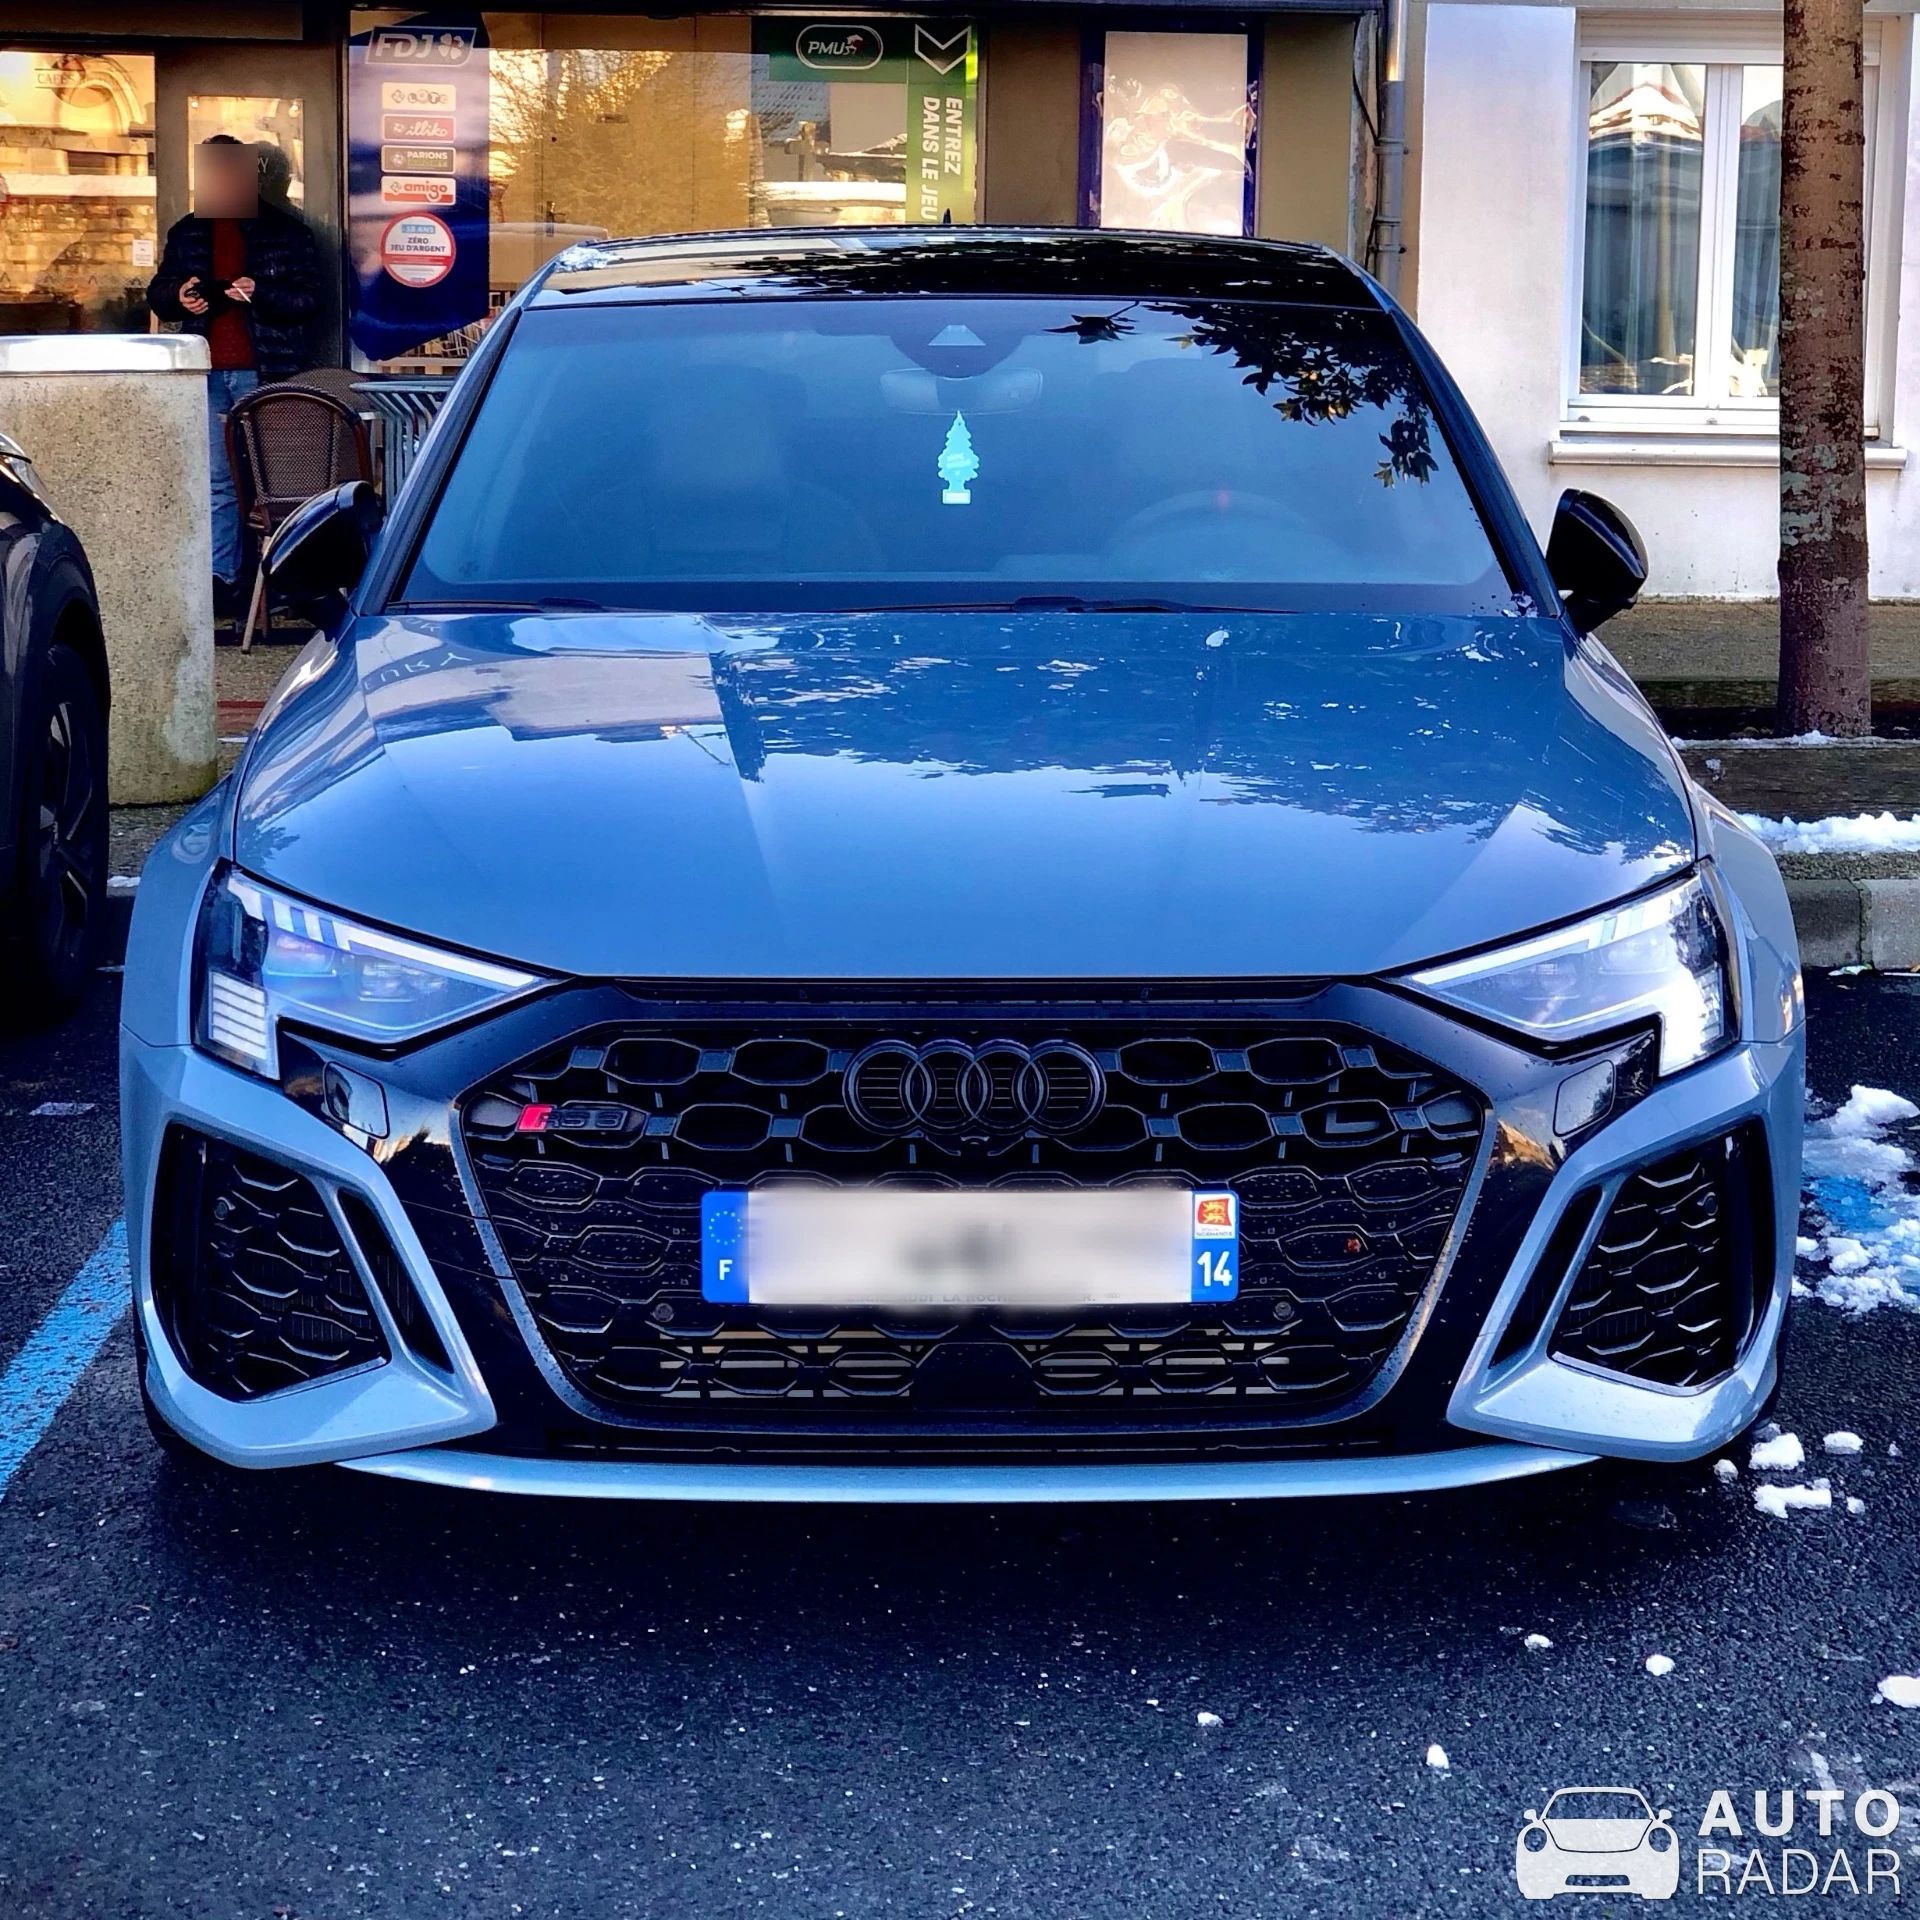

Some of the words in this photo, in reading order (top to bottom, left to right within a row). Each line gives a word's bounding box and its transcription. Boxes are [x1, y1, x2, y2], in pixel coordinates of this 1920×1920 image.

[375, 33, 435, 59] FDJ
[807, 41, 846, 55] PMU
[405, 120, 448, 136] illiko
[922, 96, 941, 154] DANS
[944, 96, 963, 176] ENTREZ
[407, 151, 448, 160] PARIONS
[921, 157, 939, 181] LE
[404, 181, 448, 199] amigo
[920, 184, 939, 221] JEU
[407, 236, 429, 244] ZÉRO
[719, 1259, 733, 1280] F
[1197, 1251, 1233, 1287] 14
